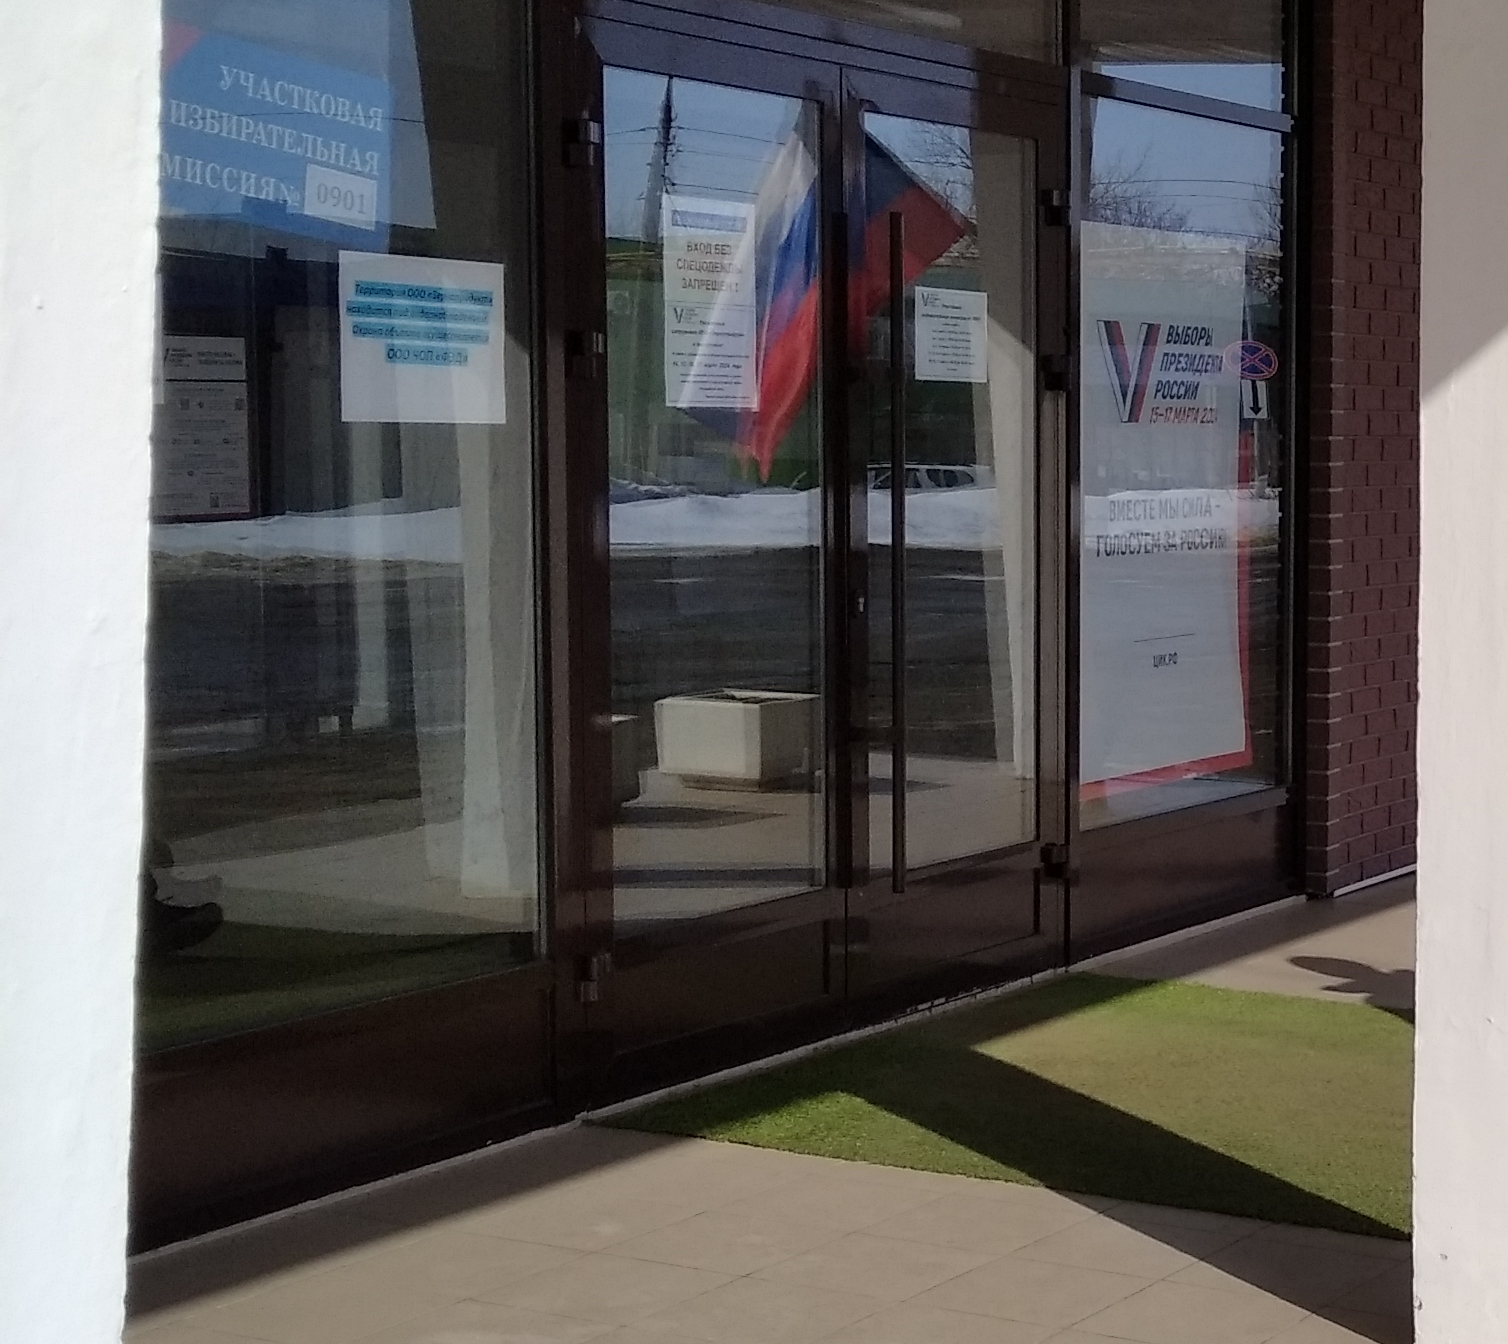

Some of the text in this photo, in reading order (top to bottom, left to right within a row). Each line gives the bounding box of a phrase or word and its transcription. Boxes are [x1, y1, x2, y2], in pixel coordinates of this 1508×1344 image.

[219, 65, 383, 132] УЧАСТКОВАЯ
[169, 99, 380, 176] ИЗБИРАТЕЛЬНАЯ
[316, 183, 367, 215] 0901
[686, 241, 713, 256] ВХОД
[1165, 324, 1214, 347] ВЫБОРЫ
[1152, 379, 1200, 400] РОССИИ
[1173, 406, 1199, 424] МАРТА
[1109, 499, 1156, 522] ВМЕСТЕ
[1158, 497, 1179, 520] МЫ
[1182, 496, 1212, 518] СИЛА
[1096, 531, 1161, 557] ГОЛОСУЕМ
[1162, 530, 1178, 552] ЗА
